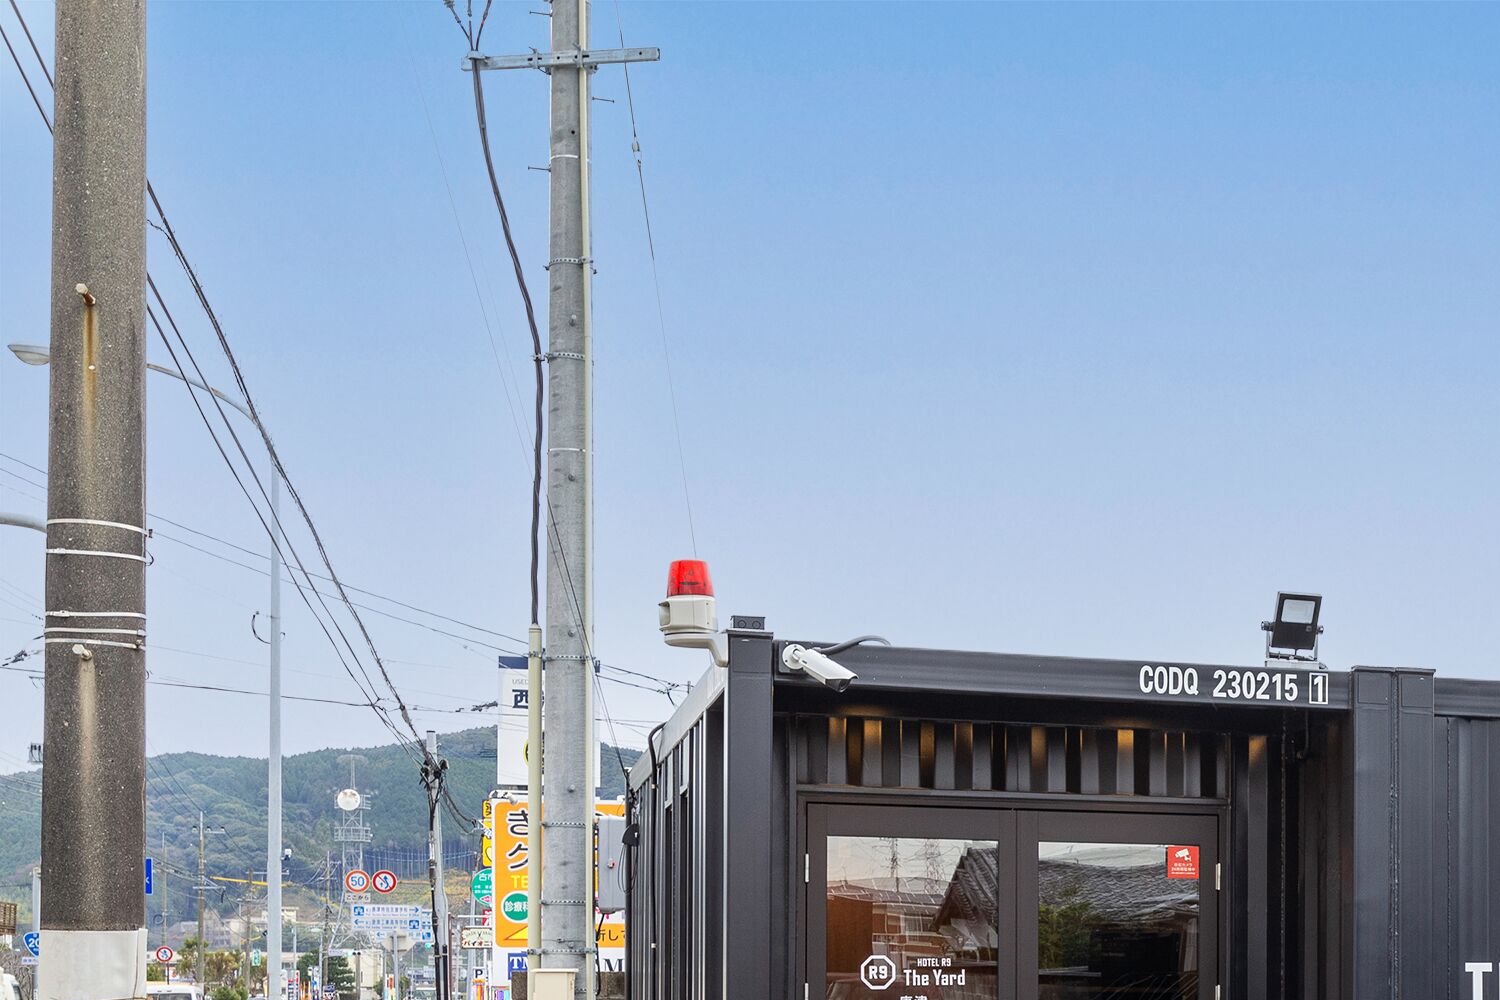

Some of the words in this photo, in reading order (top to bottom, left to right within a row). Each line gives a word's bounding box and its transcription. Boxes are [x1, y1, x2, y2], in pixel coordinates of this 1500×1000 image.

[1139, 665, 1199, 695] CODQ
[1212, 669, 1298, 701] 230215
[350, 876, 365, 887] 50
[917, 958, 939, 967] HOTEL
[941, 958, 951, 967] R9
[868, 965, 888, 980] R9
[903, 969, 929, 986] The
[933, 969, 965, 986] Yard
